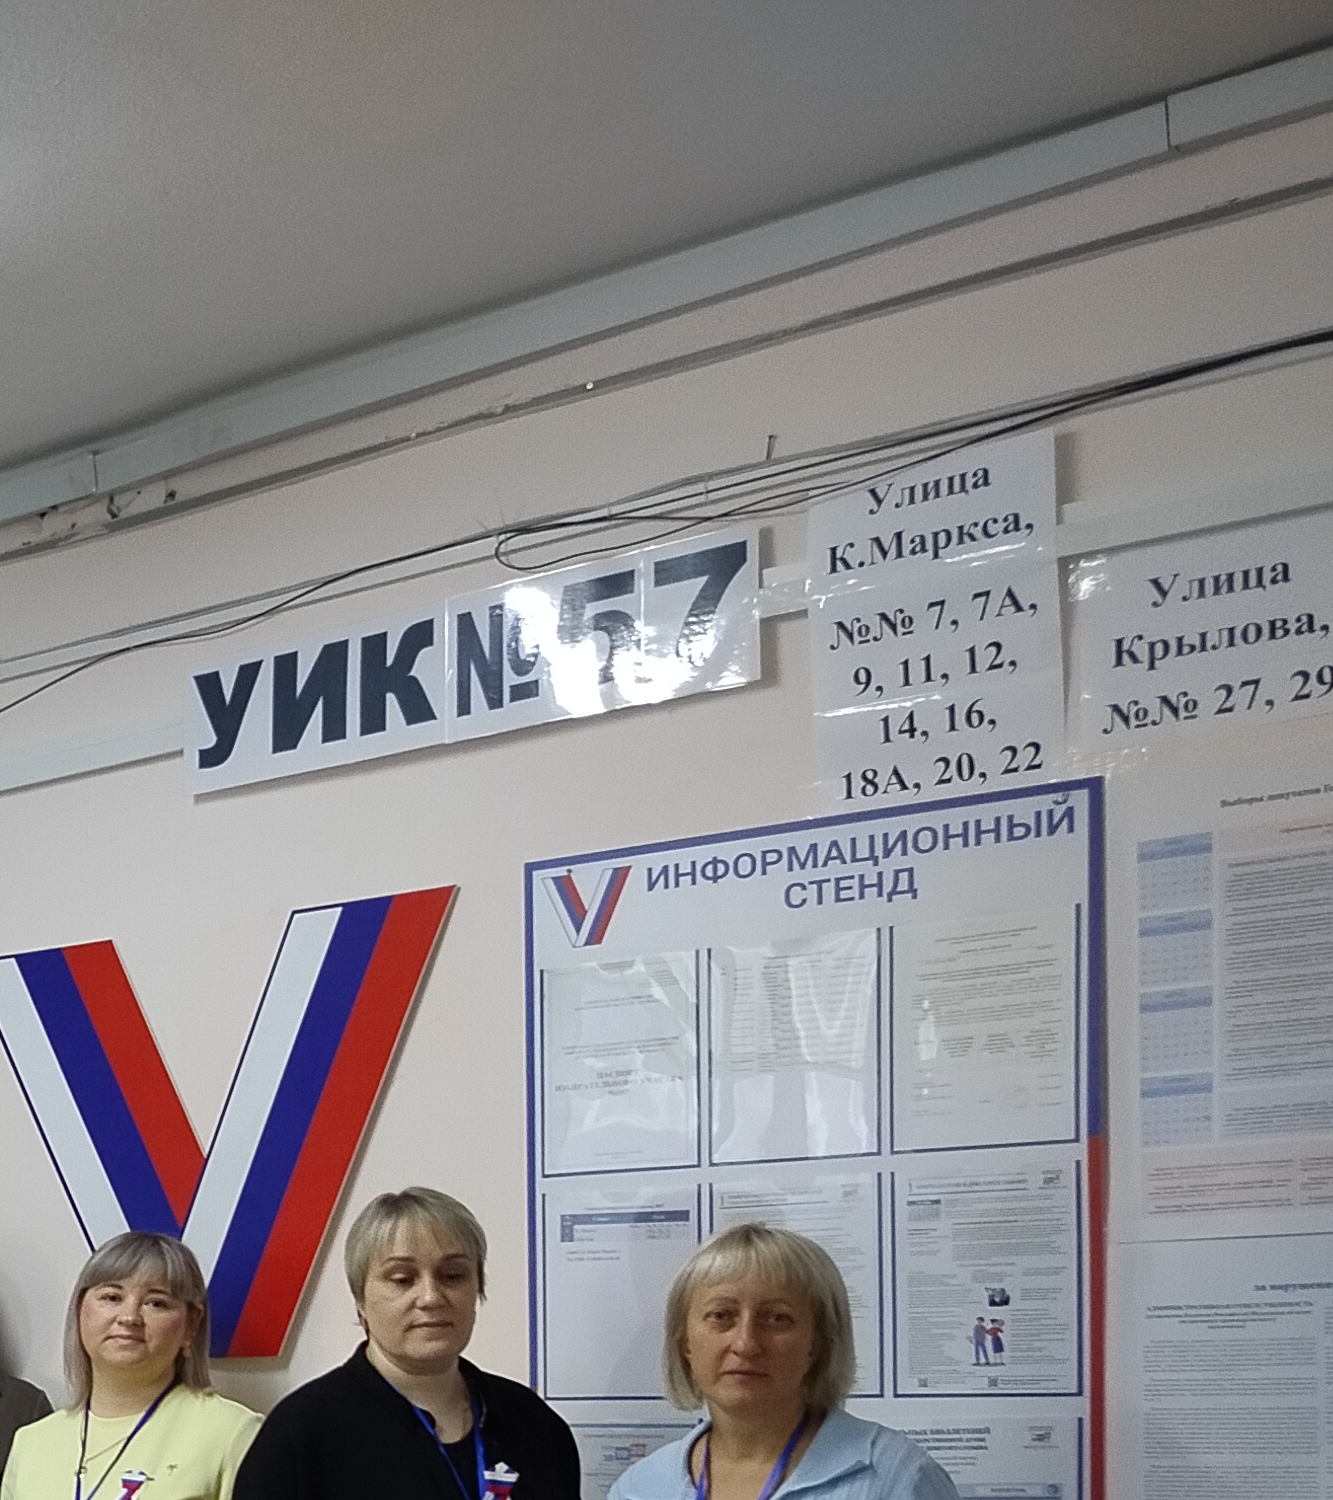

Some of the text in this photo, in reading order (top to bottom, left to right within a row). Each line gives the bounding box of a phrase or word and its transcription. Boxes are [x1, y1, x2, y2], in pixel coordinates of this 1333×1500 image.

[867, 465, 992, 516] Улица
[826, 511, 1035, 576] К.Маркса,
[1147, 560, 1292, 609] Улица
[829, 584, 1038, 651] №№ 7, 7А,
[1112, 611, 1331, 672] Крылова,
[851, 639, 1018, 699] 9, 11, 12,
[879, 697, 998, 745] 14, 16,
[1101, 690, 1199, 735] №№
[1213, 676, 1276, 716] 27,
[840, 740, 1044, 801] 18А, 20, 22
[645, 793, 1076, 893] ИНФОРМАЦИОННЫЙ
[783, 866, 919, 910] СТЕНД
